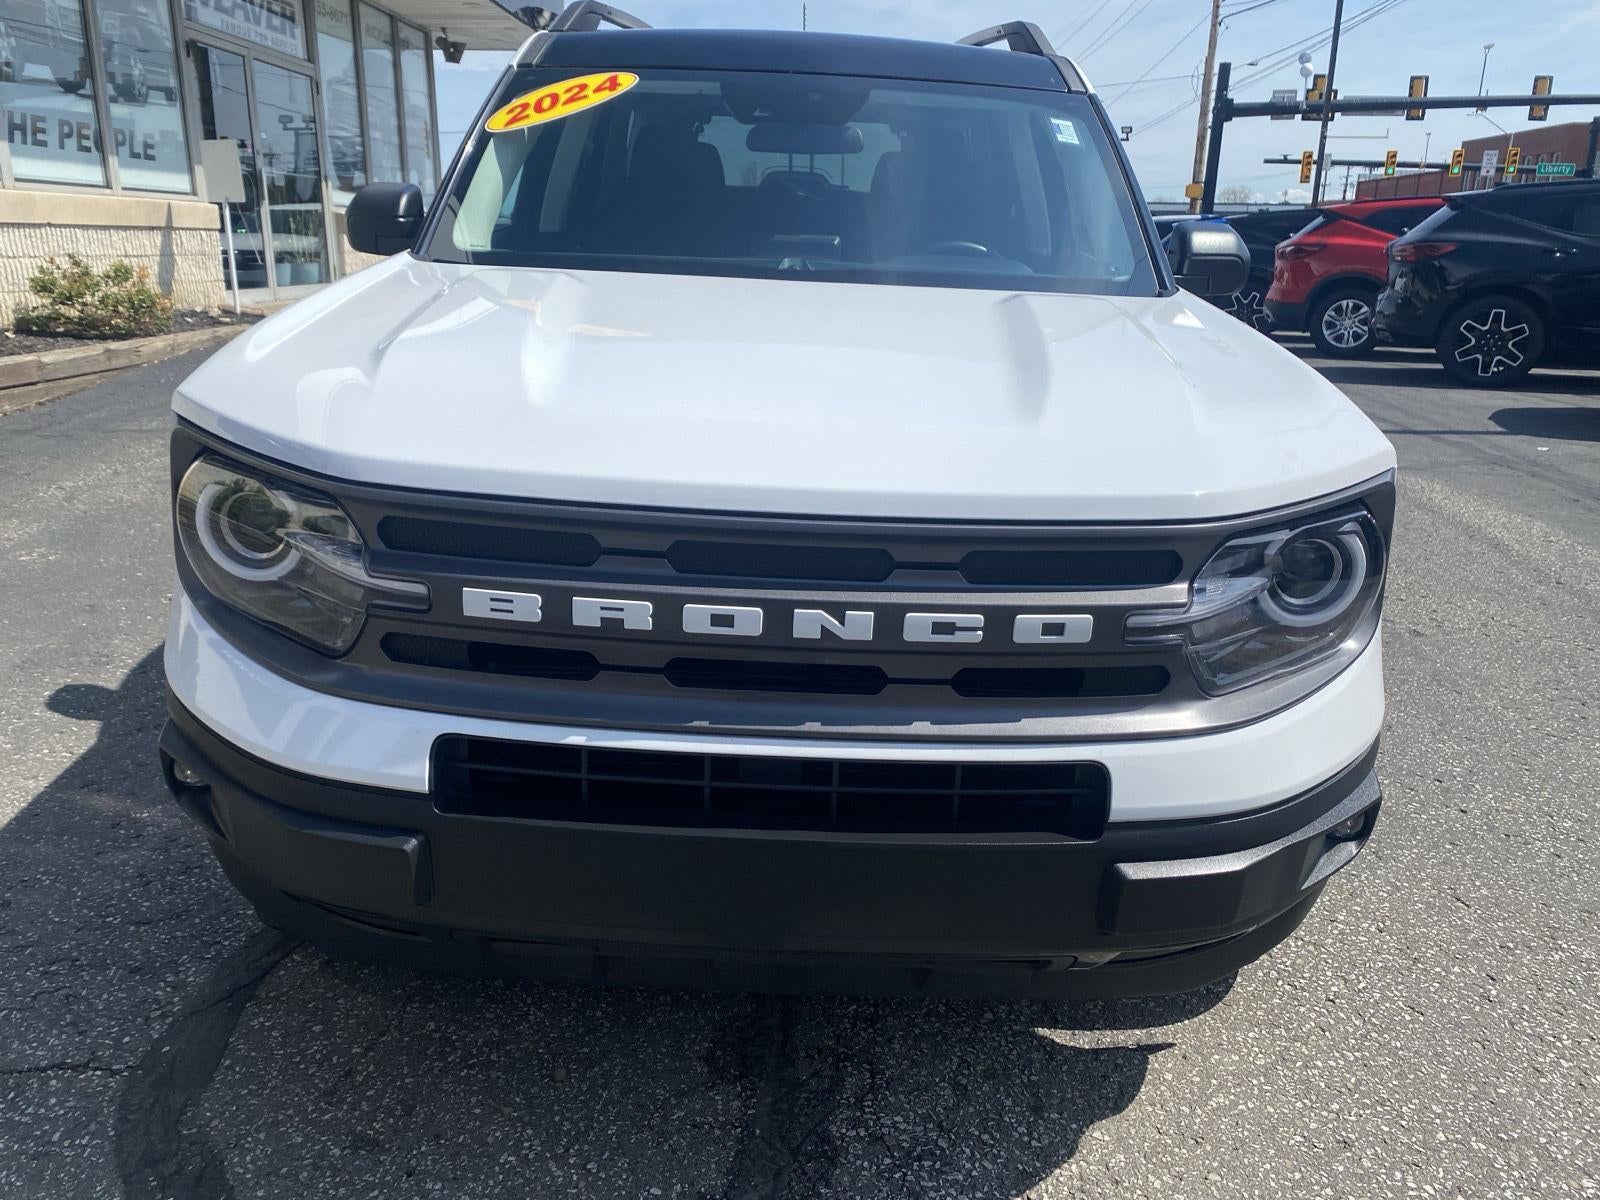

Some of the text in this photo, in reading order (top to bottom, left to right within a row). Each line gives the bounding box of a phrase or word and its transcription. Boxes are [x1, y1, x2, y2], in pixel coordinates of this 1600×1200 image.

[198, 0, 297, 40] AVER
[504, 74, 622, 128] 2024
[4, 109, 48, 148] HE
[1541, 164, 1571, 174] Liberty
[463, 586, 1094, 644] BRONCO
